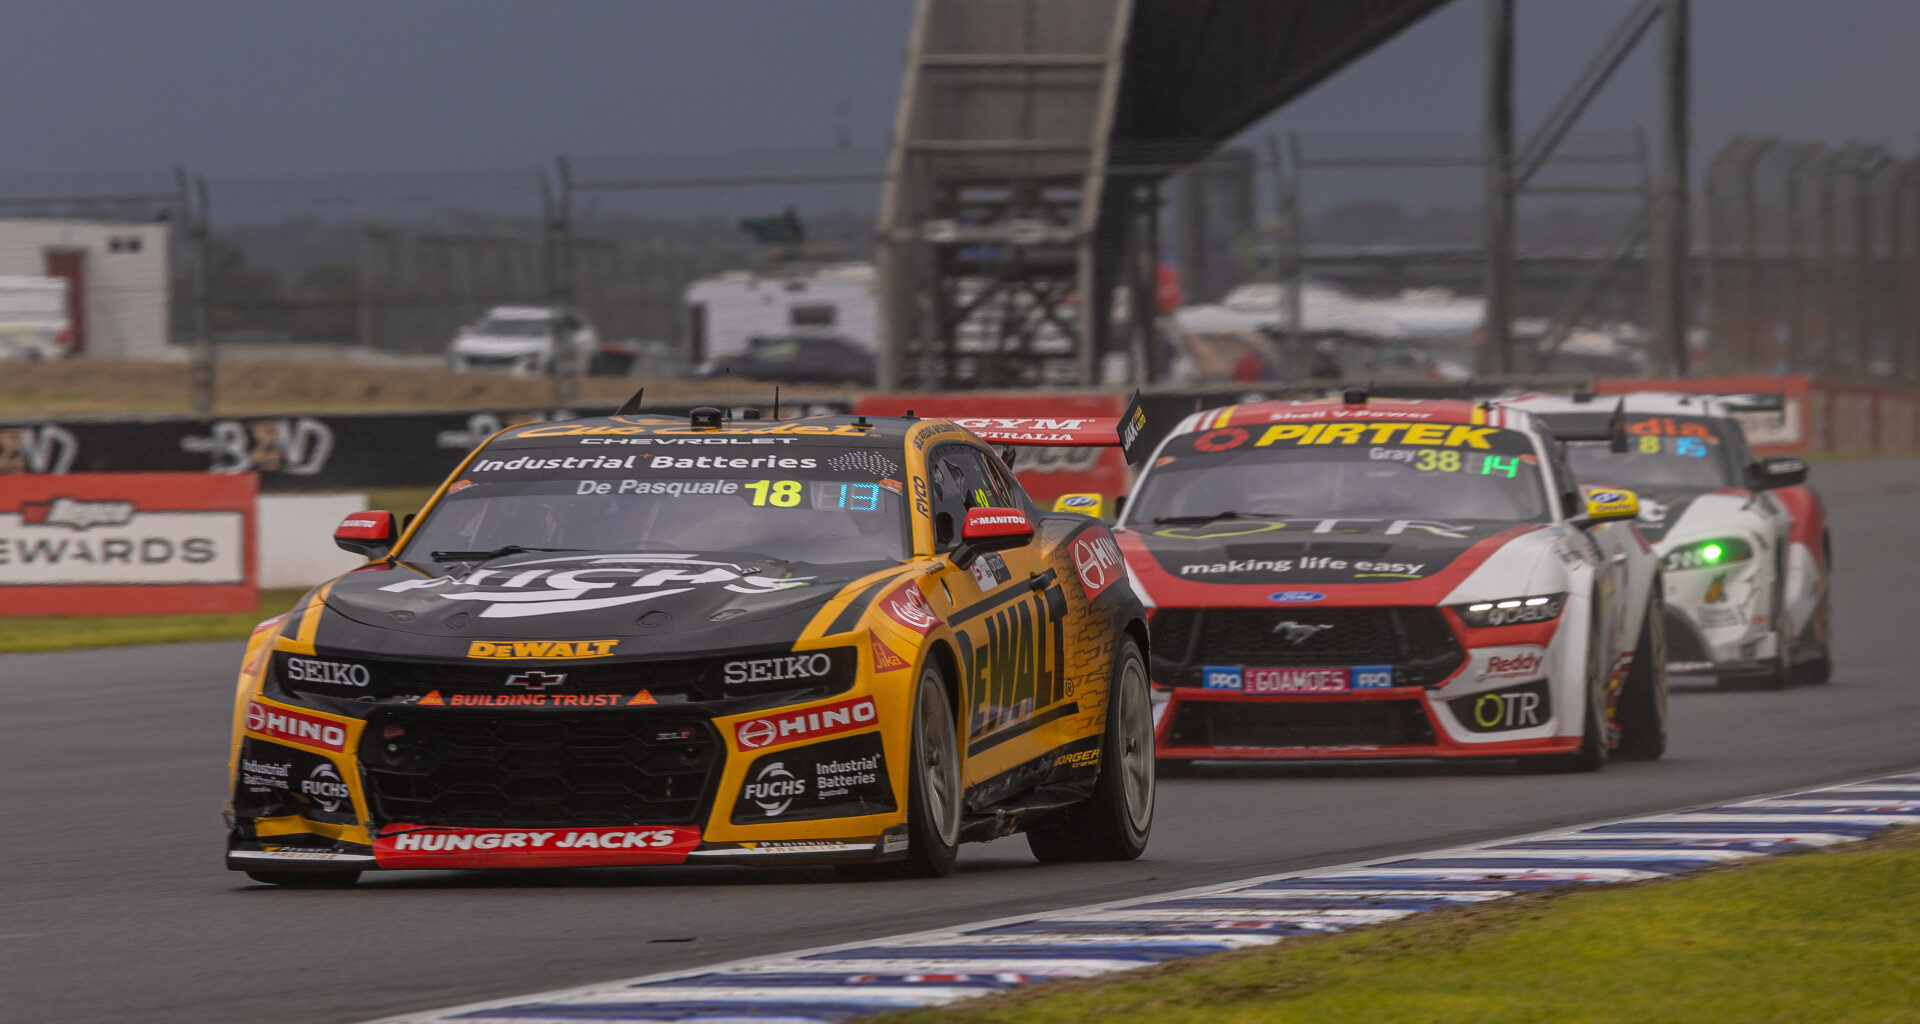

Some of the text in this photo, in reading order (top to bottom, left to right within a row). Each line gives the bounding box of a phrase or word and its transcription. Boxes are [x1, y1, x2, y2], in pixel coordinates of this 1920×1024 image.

[954, 418, 1087, 430] GYM
[1270, 411, 1327, 420] Shell
[516, 424, 646, 438] Cub
[974, 431, 1074, 441] STRALIA
[1254, 423, 1502, 449] PIRTEK
[0, 425, 79, 475] END
[580, 437, 800, 446] CHEVROLET
[1639, 435, 1660, 454] 8
[472, 454, 818, 474] Industrial Batteries
[1369, 447, 1461, 473] Gray 38
[1481, 455, 1520, 479] 14
[576, 478, 803, 508] De Pasquale 18
[838, 483, 880, 511] 13
[912, 475, 930, 519] RYCO
[979, 515, 1026, 525] MANITOU
[1153, 518, 1475, 539] OTR
[1180, 556, 1425, 576] making life easy
[467, 640, 620, 659] DEWALT
[287, 657, 371, 687] SEIKO
[723, 652, 832, 684] SEIKO
[1487, 653, 1544, 673] Reddy
[449, 694, 547, 706] BUILDING
[551, 694, 622, 706] TRUST
[1474, 691, 1541, 728] OTR
[267, 712, 346, 746] HINO
[777, 701, 876, 737] HINO
[815, 755, 878, 775] Industrial
[301, 780, 349, 797] FUCHS
[744, 779, 806, 799] FUCHS
[816, 772, 876, 789] Batteries
[394, 829, 677, 852] HUNGRY JACK'S
